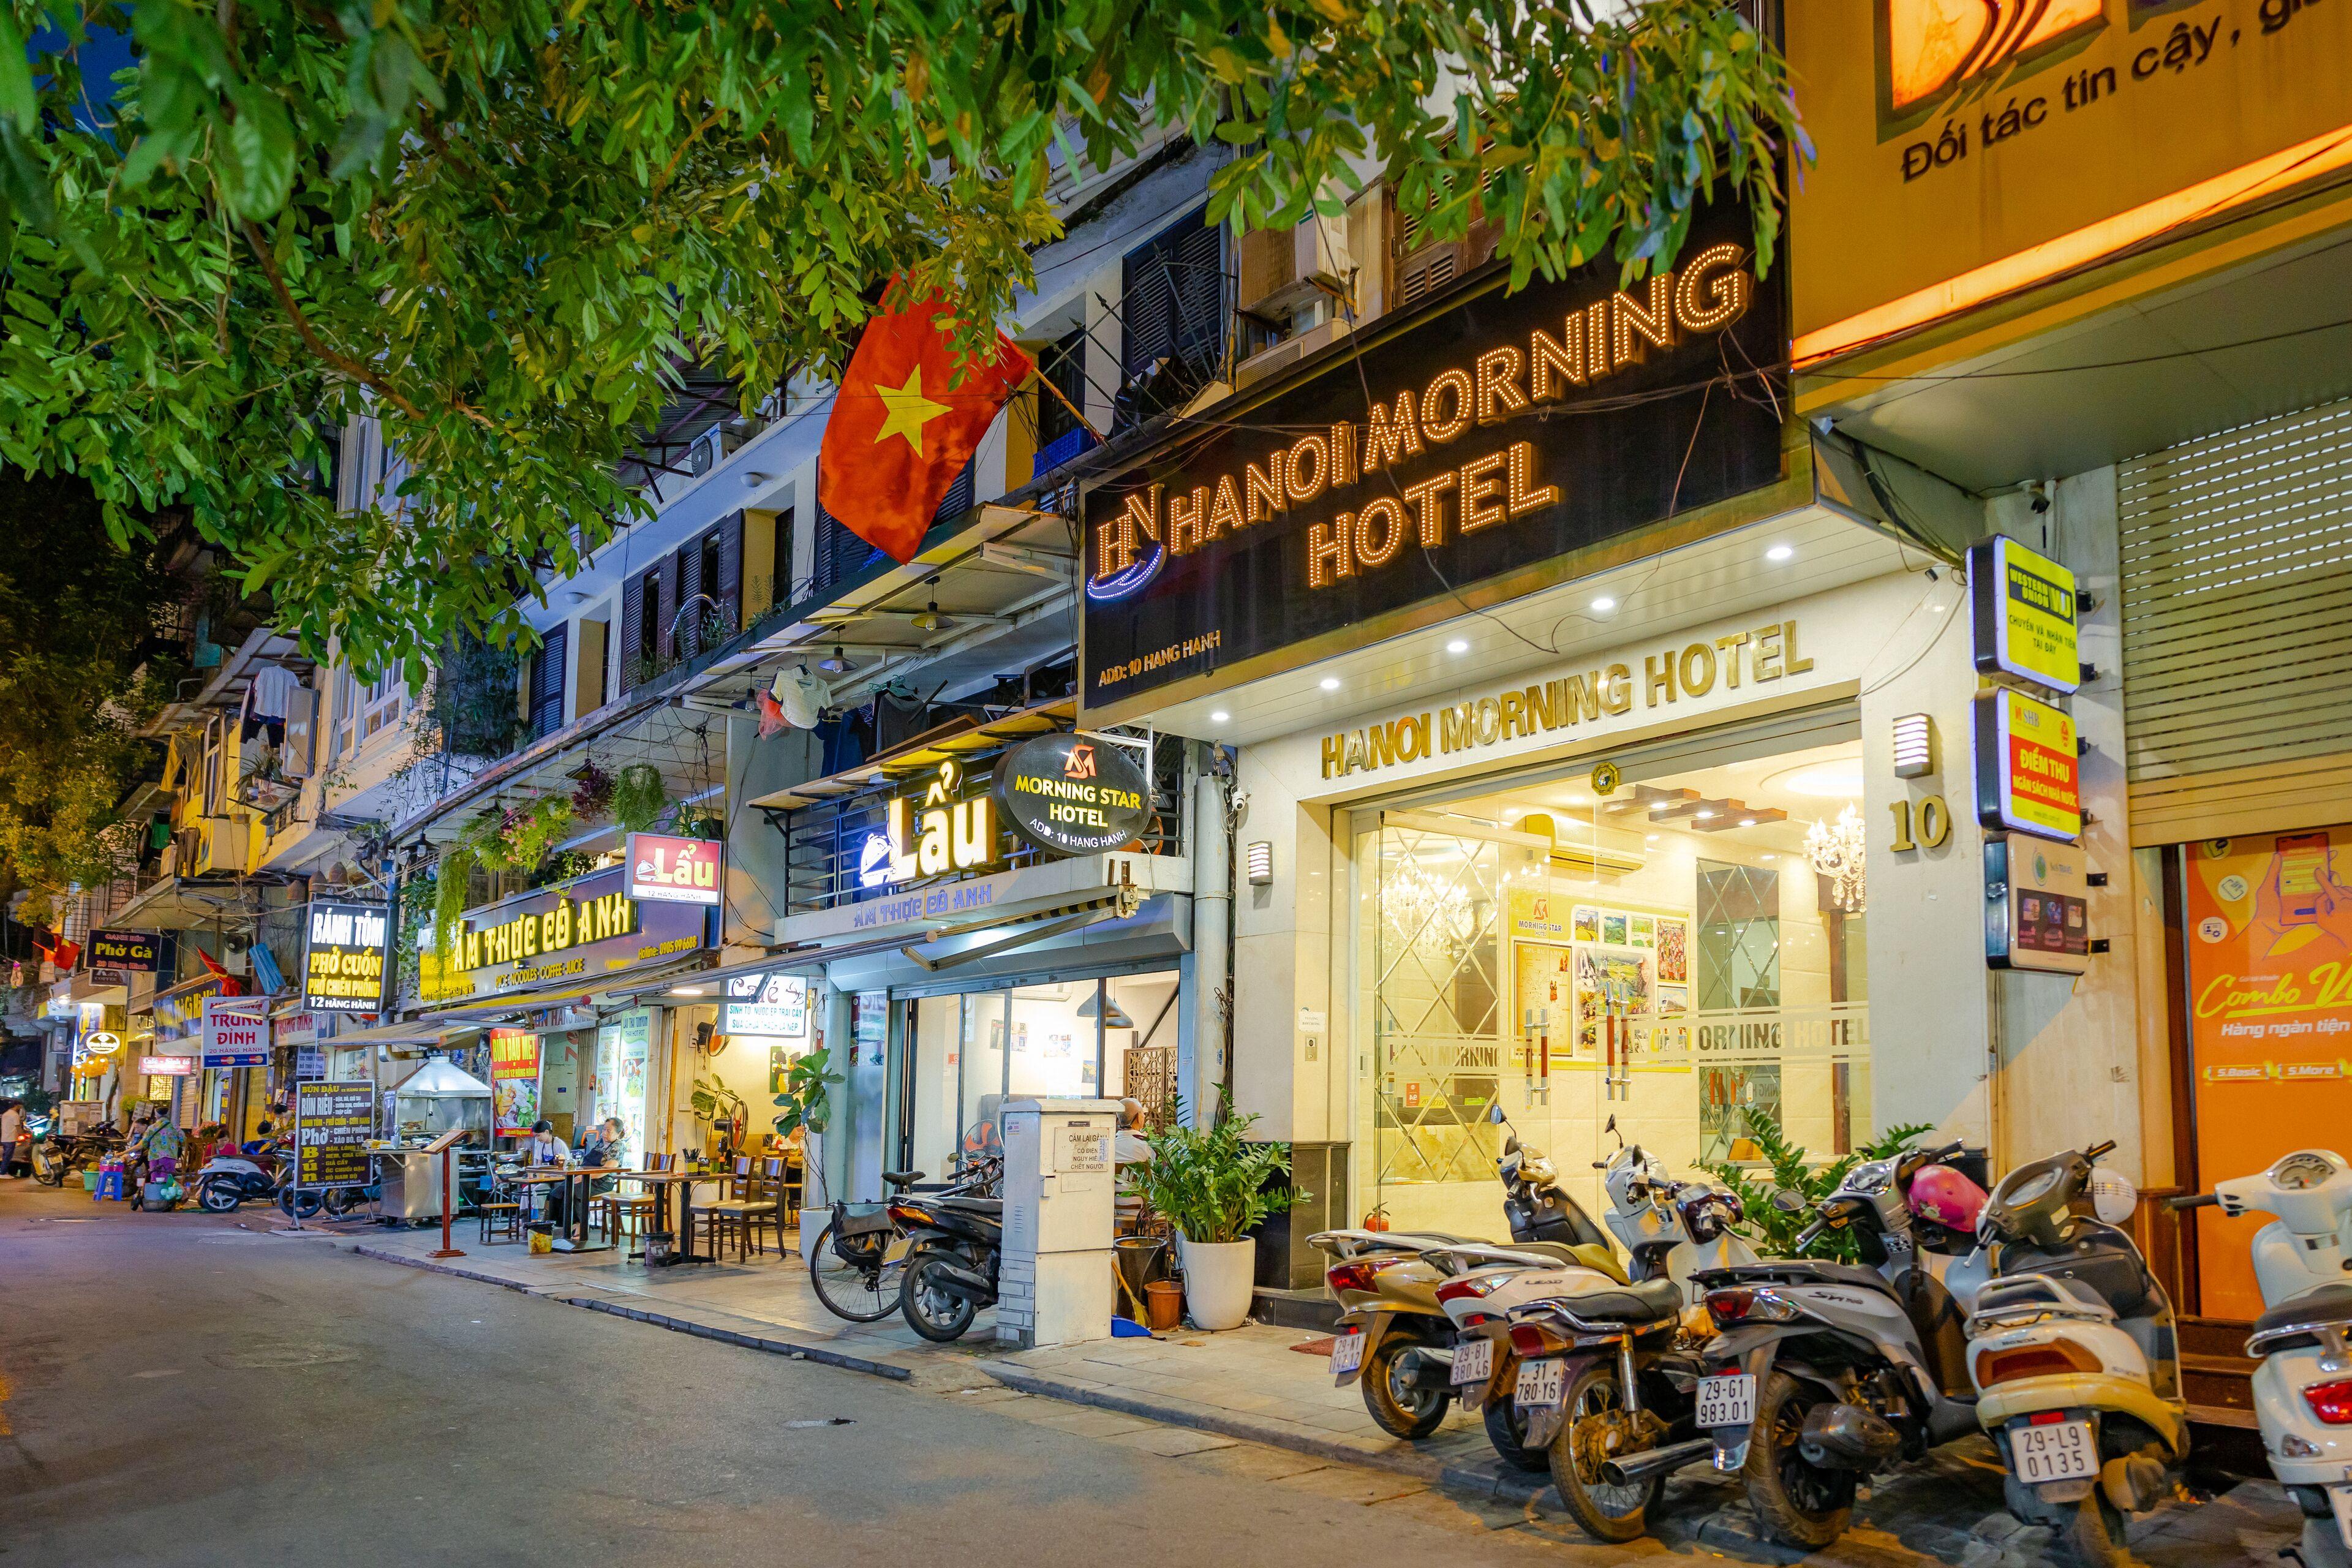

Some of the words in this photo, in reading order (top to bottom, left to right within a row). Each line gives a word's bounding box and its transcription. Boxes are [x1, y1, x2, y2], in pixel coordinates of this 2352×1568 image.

[1900, 116, 1967, 183] Đối
[1981, 97, 2048, 149] tác
[2062, 64, 2116, 111] tin
[1169, 421, 1356, 556] HANOI
[1364, 243, 1748, 472] MORNING
[1307, 440, 1559, 589] HOTEL
[2009, 568, 2049, 597] WESTERN
[2022, 586, 2049, 608] UNION
[1098, 665, 1127, 687] ADD:
[1128, 658, 1142, 676] 10
[1144, 644, 1180, 671] HANG
[1183, 630, 1221, 658] HANH
[1321, 712, 1431, 780] HANOI
[1439, 663, 1632, 754] MORNING
[1645, 619, 1814, 708] HOTEL
[2049, 759, 2070, 783] THU
[1014, 774, 1096, 803] MORNING
[1099, 788, 1142, 810] STAR
[1049, 802, 1109, 828] HOTEL
[1888, 794, 1950, 852] 10
[1029, 818, 1054, 839] ADD:
[1057, 832, 1068, 844] 10
[1069, 835, 1099, 848] HANG
[1100, 829, 1128, 847] HANH
[654, 843, 715, 888] Lẩu
[925, 889, 949, 915] CÔ
[952, 883, 992, 910] ANH
[311, 907, 353, 945] BÁNH
[354, 910, 385, 948] TÔM
[542, 898, 576, 953] CÔ
[577, 892, 635, 944] ANH
[95, 942, 127, 957] Phở
[130, 945, 153, 959] Gà
[341, 946, 383, 977] CUỐN
[309, 996, 325, 1008] 12
[325, 998, 350, 1009] HÀNG
[350, 998, 376, 1010] HÀNH
[731, 978, 778, 1004] Caé
[2196, 972, 2302, 1019] Combo
[216, 1028, 256, 1046] ĐỈNH
[2221, 1022, 2265, 1039] Hàng
[2267, 1020, 2313, 1038] ngàn
[2316, 1017, 2351, 1036] tiện
[492, 1033, 507, 1062] BÚN
[522, 1035, 536, 1066] MẸT
[302, 1085, 319, 1093] BÚN
[301, 1093, 316, 1116] BÚN
[300, 1126, 330, 1146] Phở
[1532, 1362, 1547, 1381] 31
[1705, 1378, 1744, 1401] 29-G1
[1700, 1400, 1749, 1423] 983.01
[2022, 1426, 2081, 1453] 29-L9
[2027, 1450, 2085, 1477] 0135
